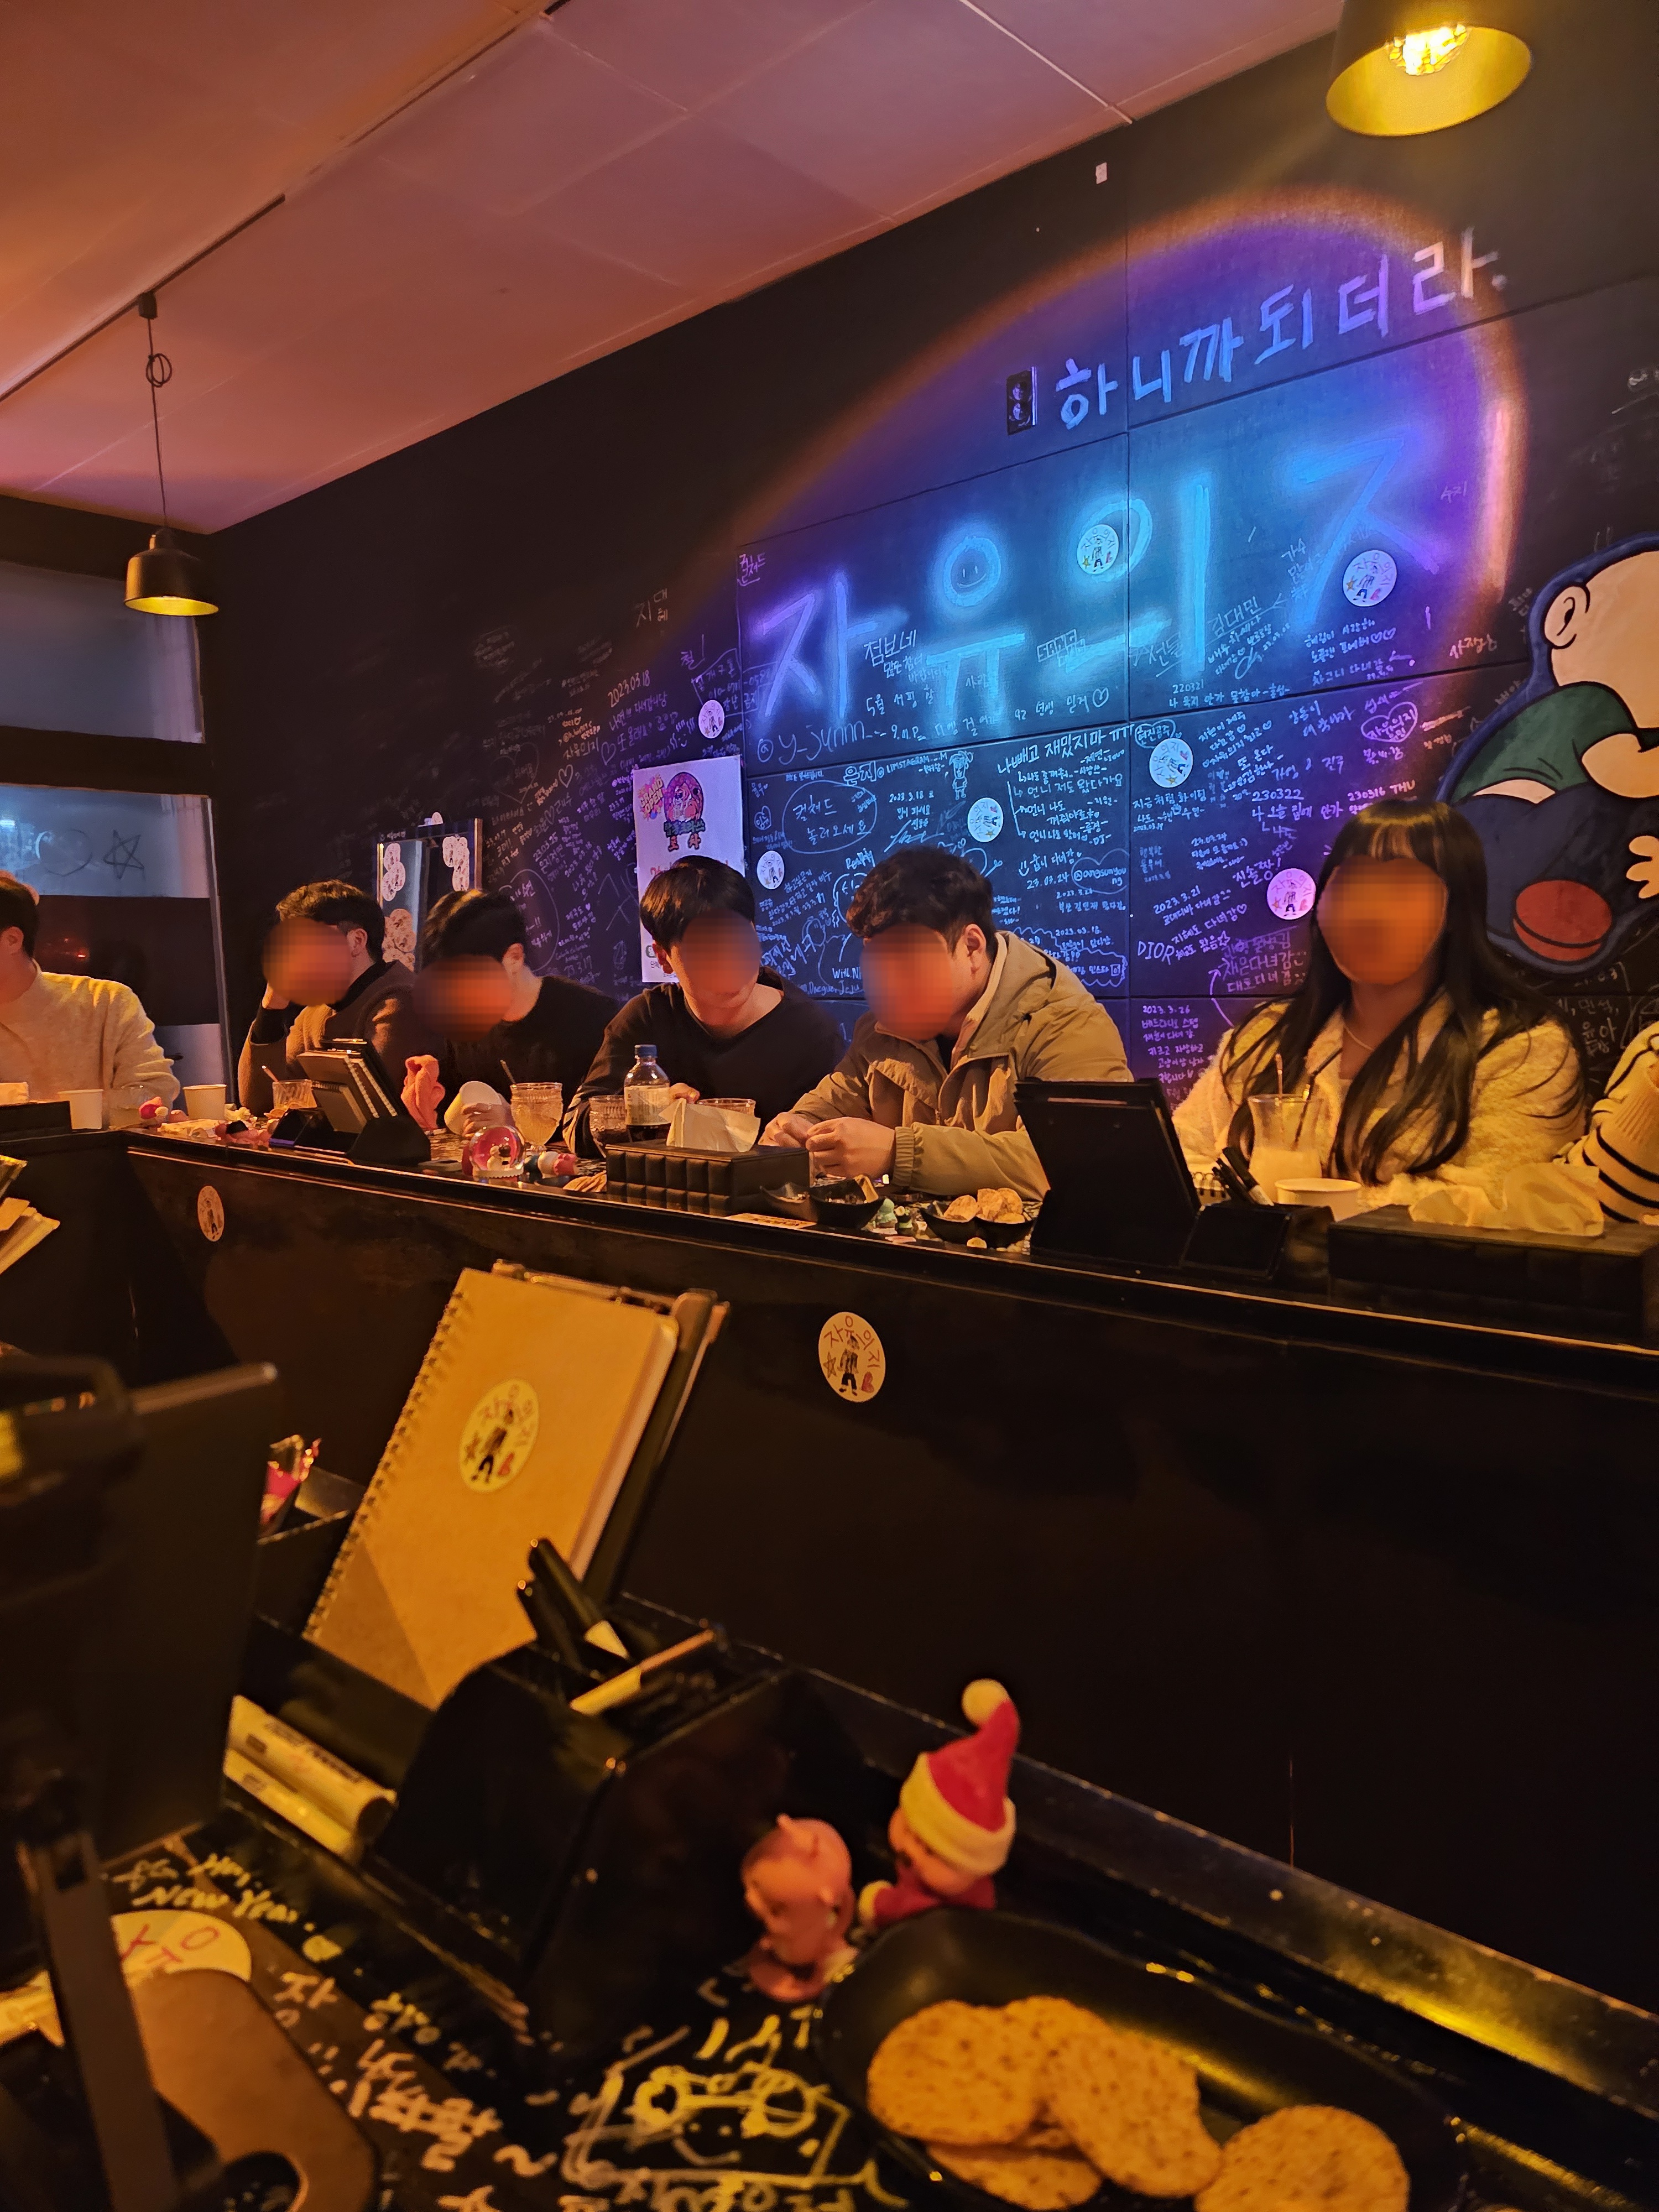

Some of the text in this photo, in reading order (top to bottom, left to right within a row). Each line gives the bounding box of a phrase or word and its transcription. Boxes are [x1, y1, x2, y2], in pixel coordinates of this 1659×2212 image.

[640, 778, 663, 808] GRAND
[644, 788, 663, 813] OPEN
[1251, 787, 1305, 802] 230322
[1272, 871, 1312, 896] 자유의지
[1137, 940, 1176, 966] DIOR
[823, 1315, 881, 1368] 자유의지
